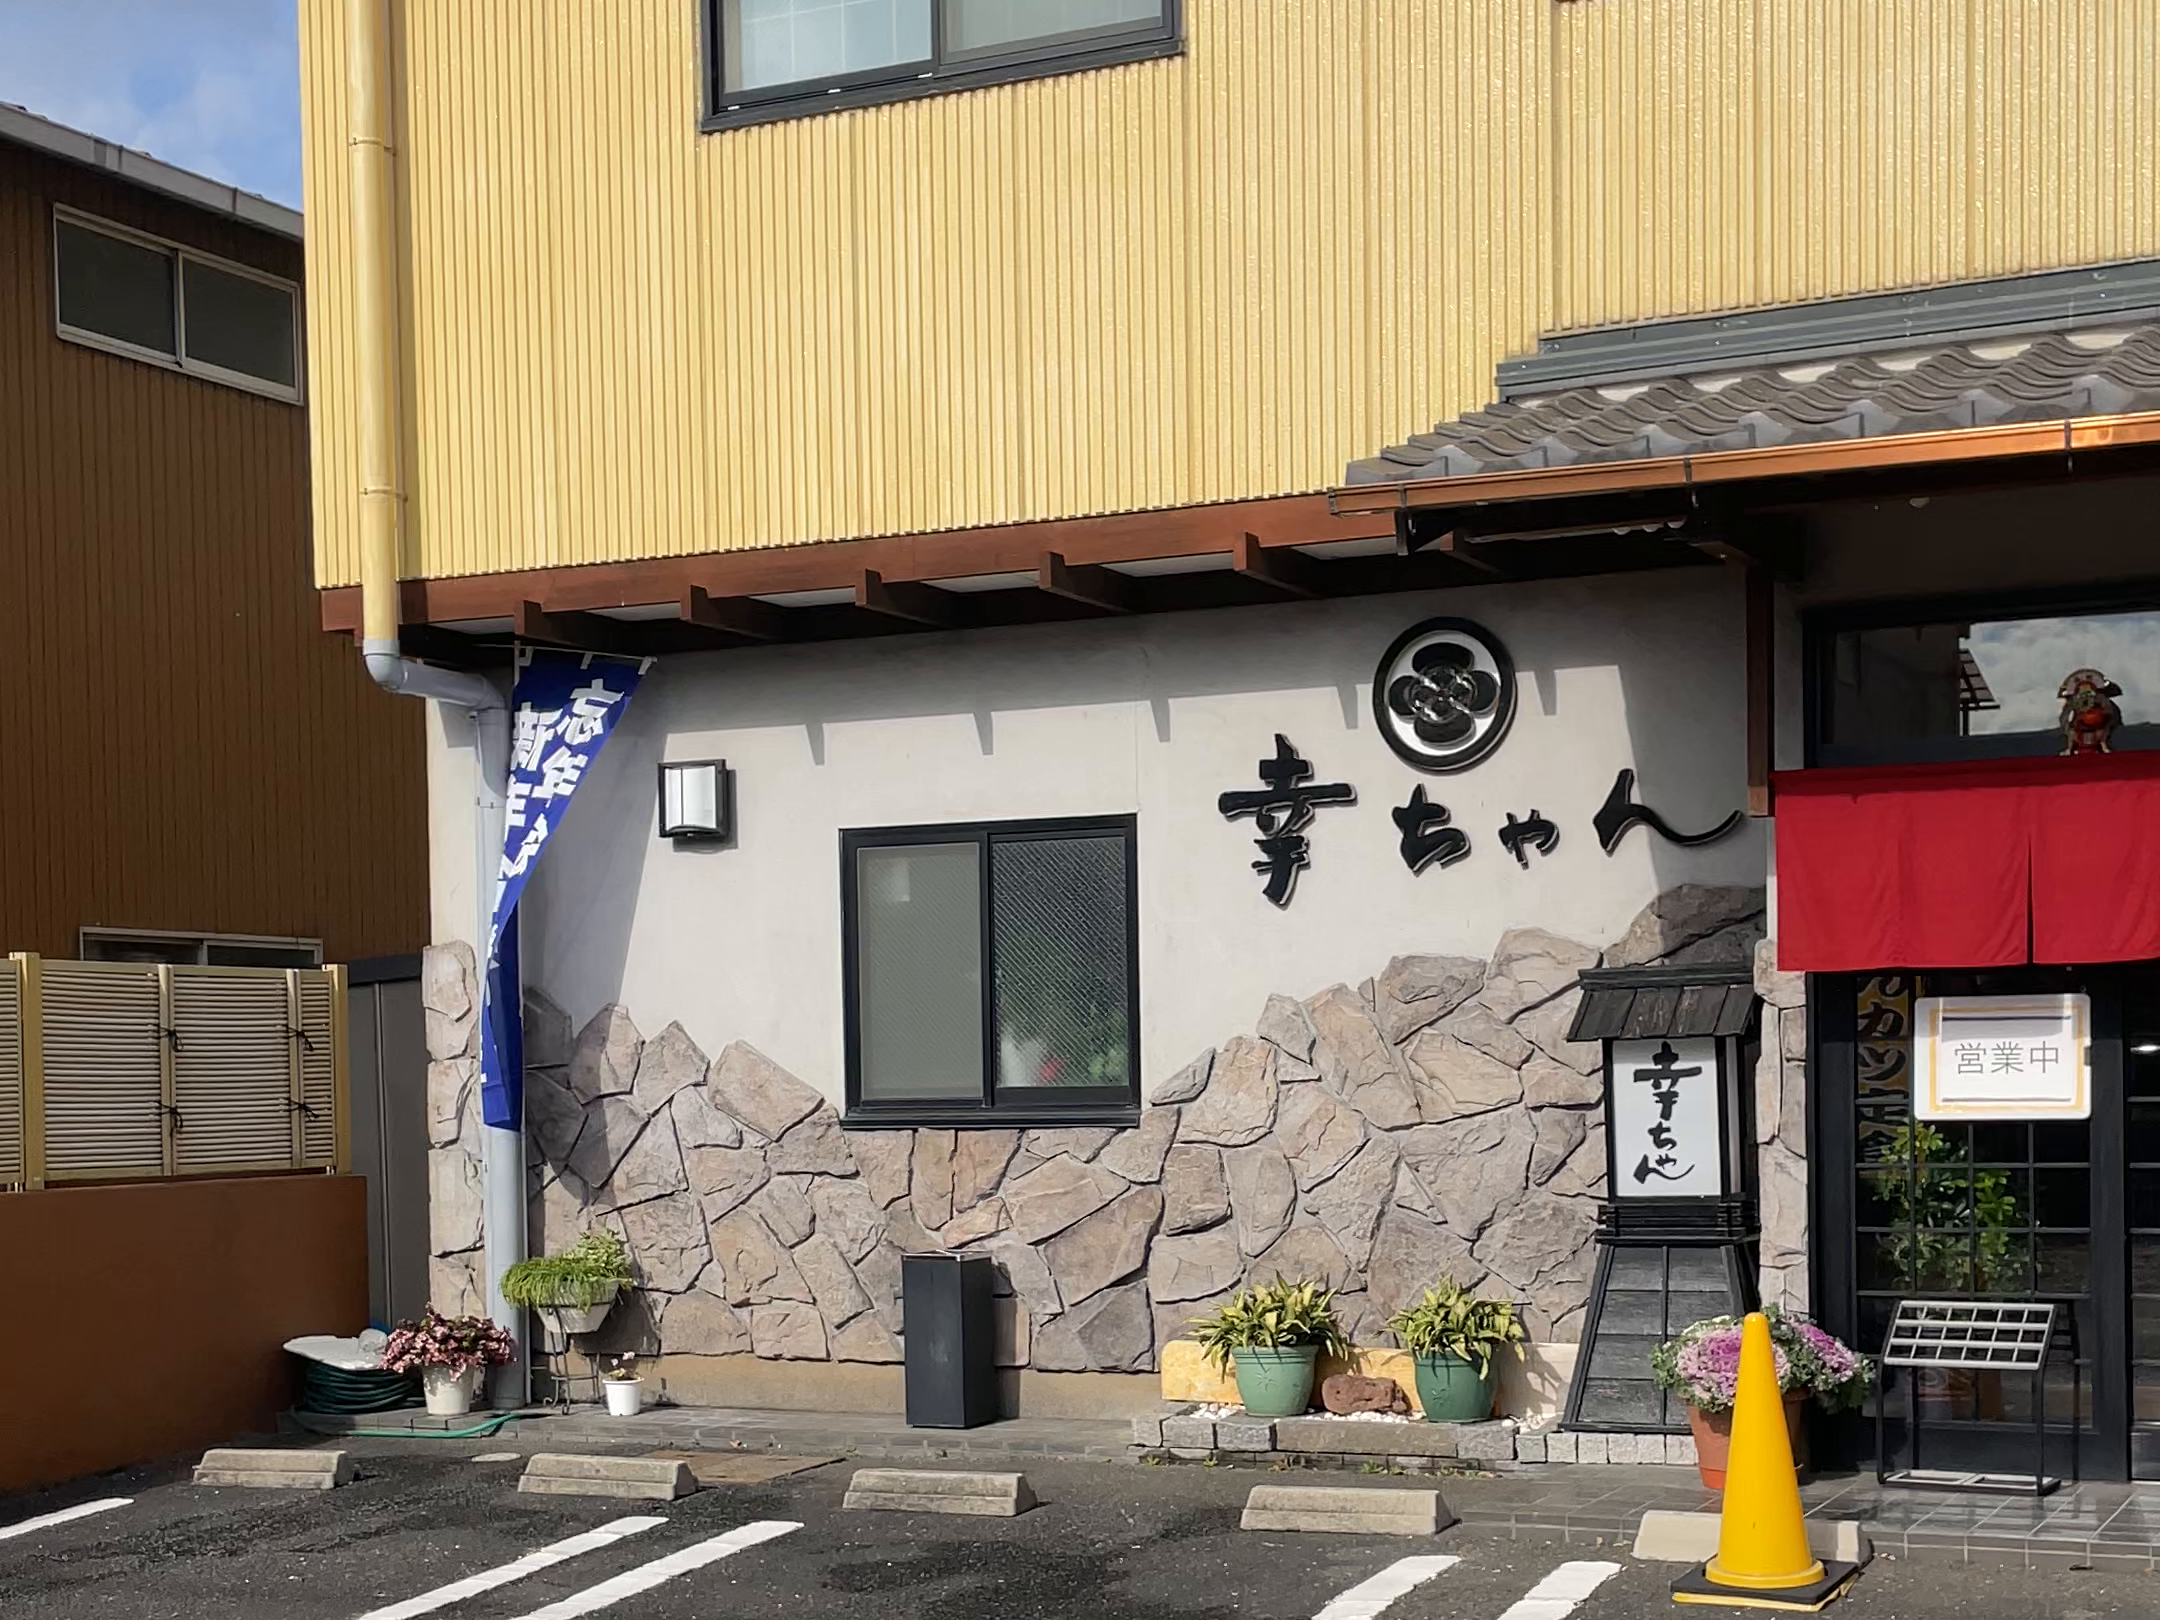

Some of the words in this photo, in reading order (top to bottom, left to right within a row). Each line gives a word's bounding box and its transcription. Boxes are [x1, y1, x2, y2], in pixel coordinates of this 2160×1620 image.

[1217, 733, 1741, 909] 幸ちゃん
[1632, 1040, 1703, 1185] 幸ちゃん
[1954, 1040, 2060, 1076] 営業中
